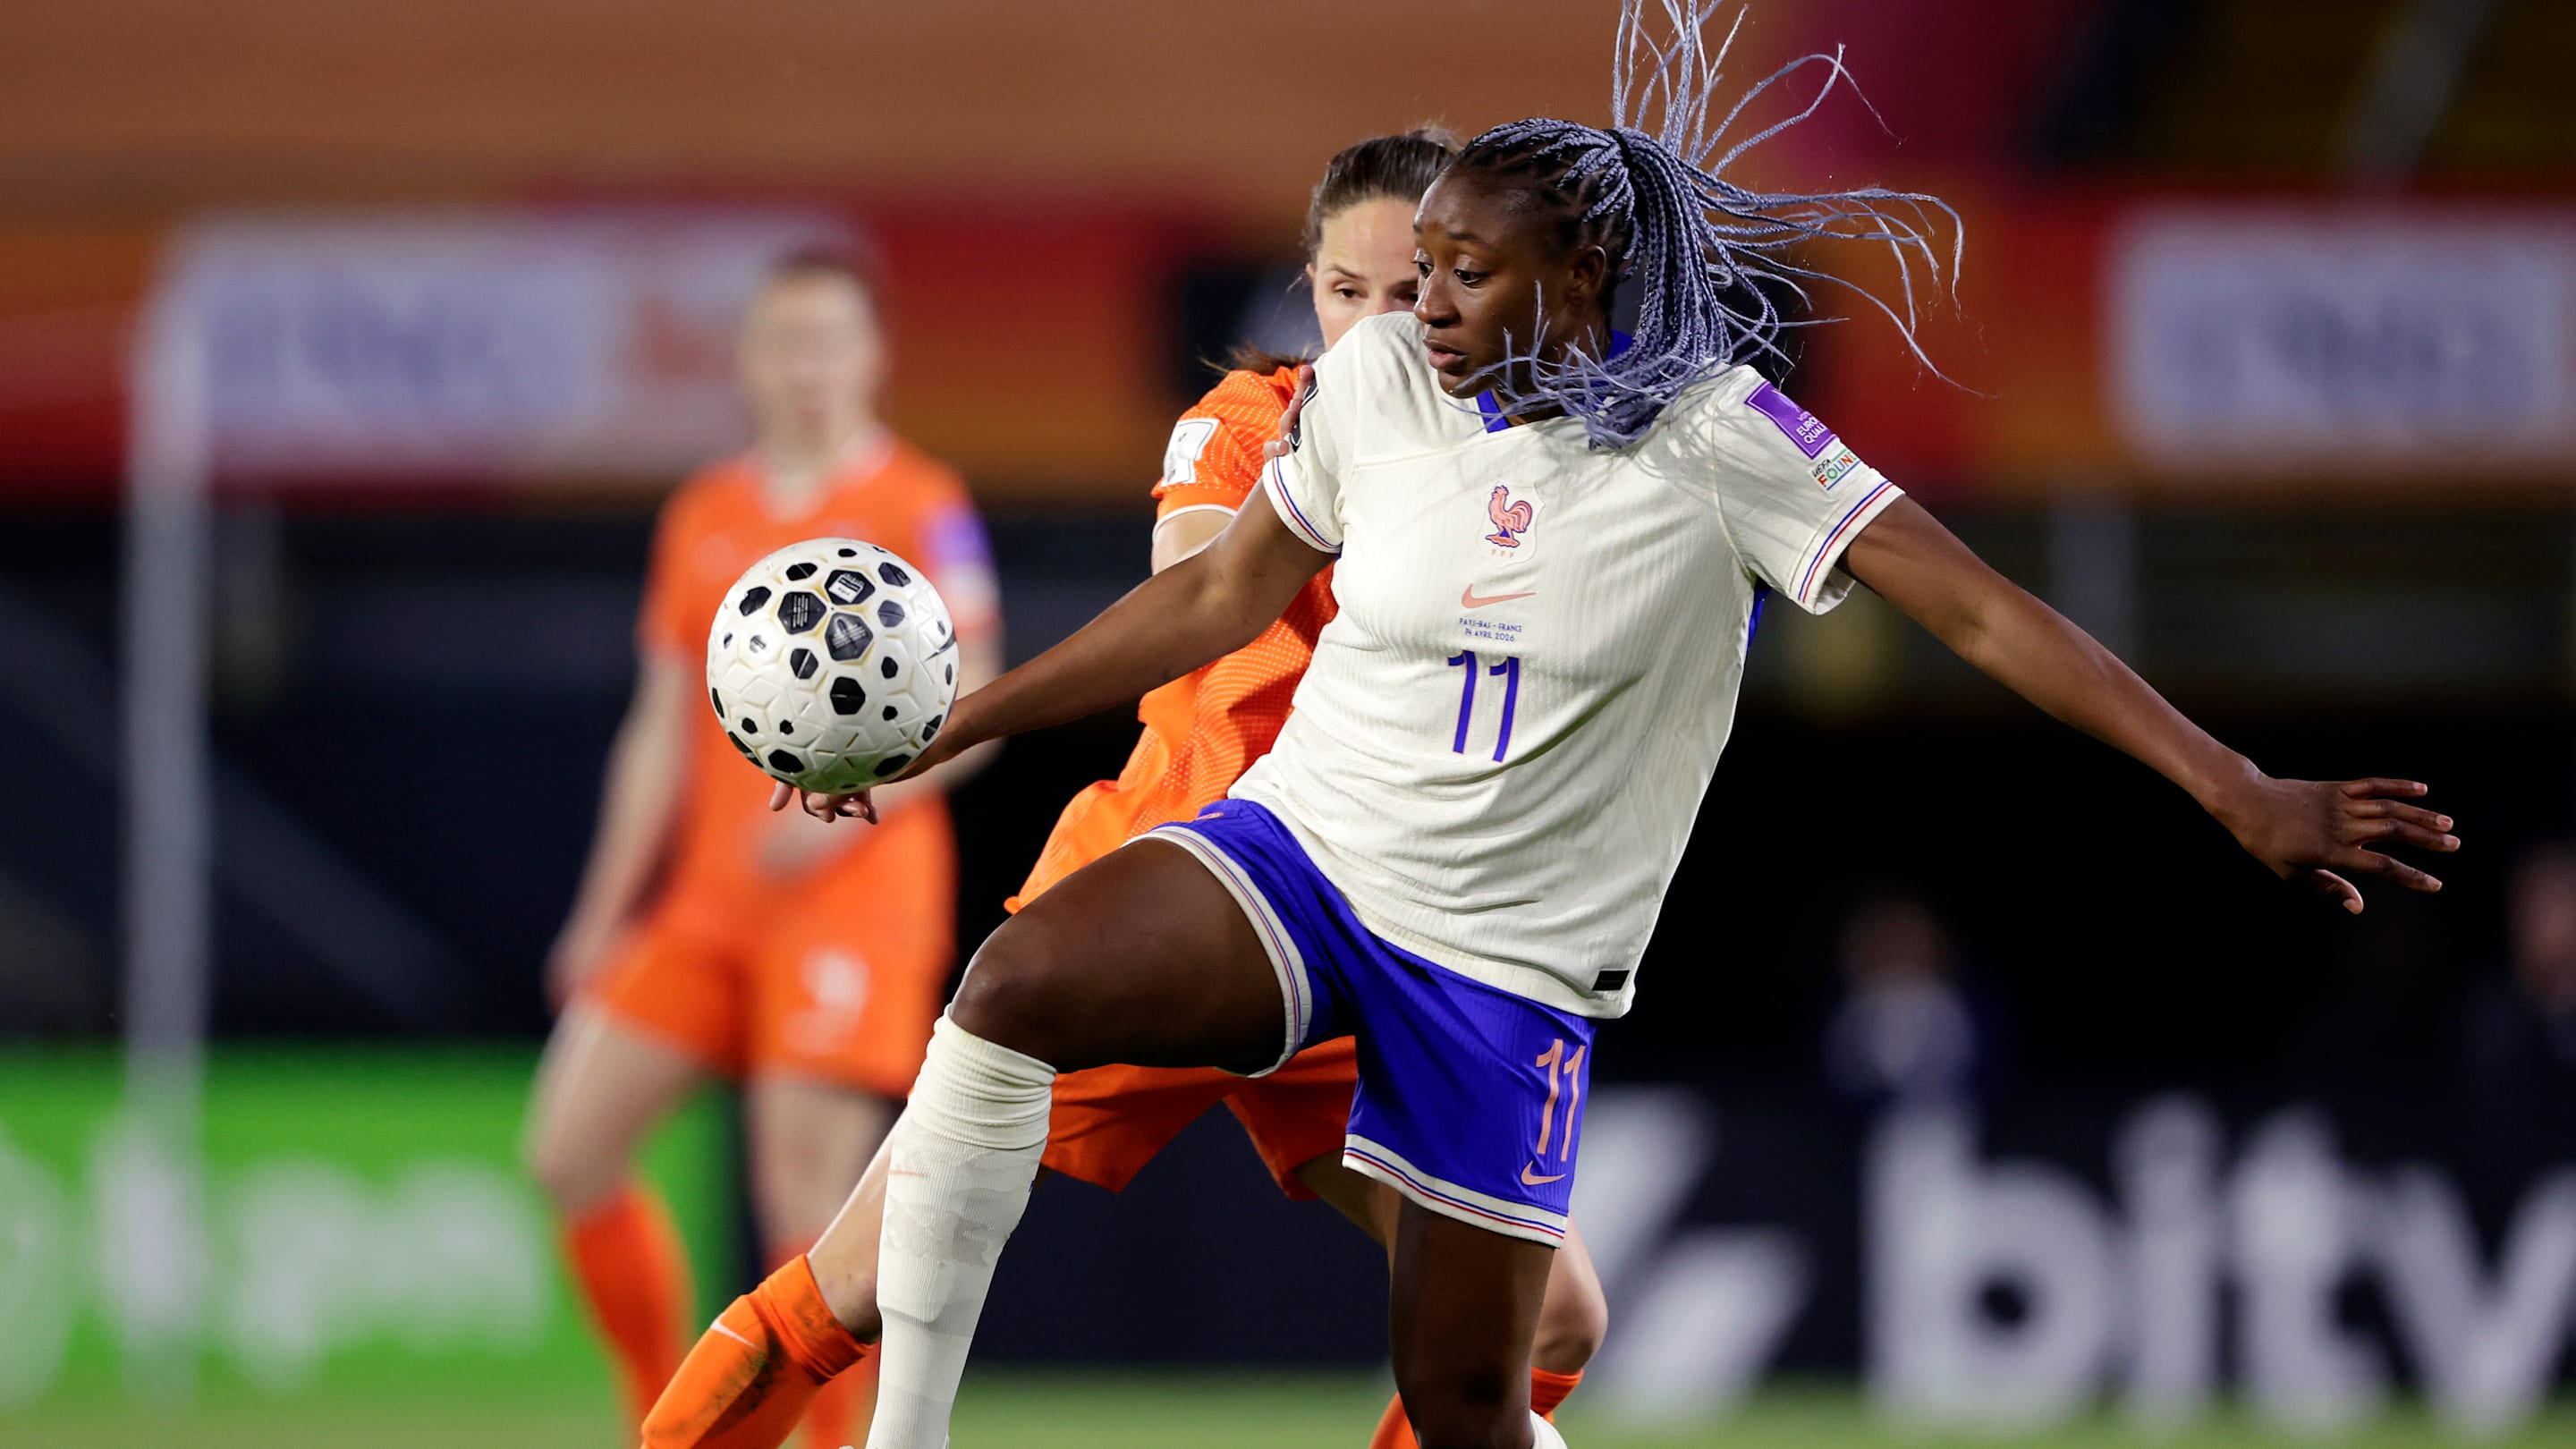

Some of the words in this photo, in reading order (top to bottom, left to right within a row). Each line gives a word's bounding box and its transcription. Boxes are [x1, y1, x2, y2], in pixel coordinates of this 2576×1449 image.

[1812, 459, 1832, 478] UEFA
[1475, 630, 1493, 639] AVRIL
[1496, 632, 1515, 642] 2026
[1498, 623, 1522, 633] FRANCE
[1446, 649, 1520, 763] 11
[1536, 1038, 1587, 1162] 11
